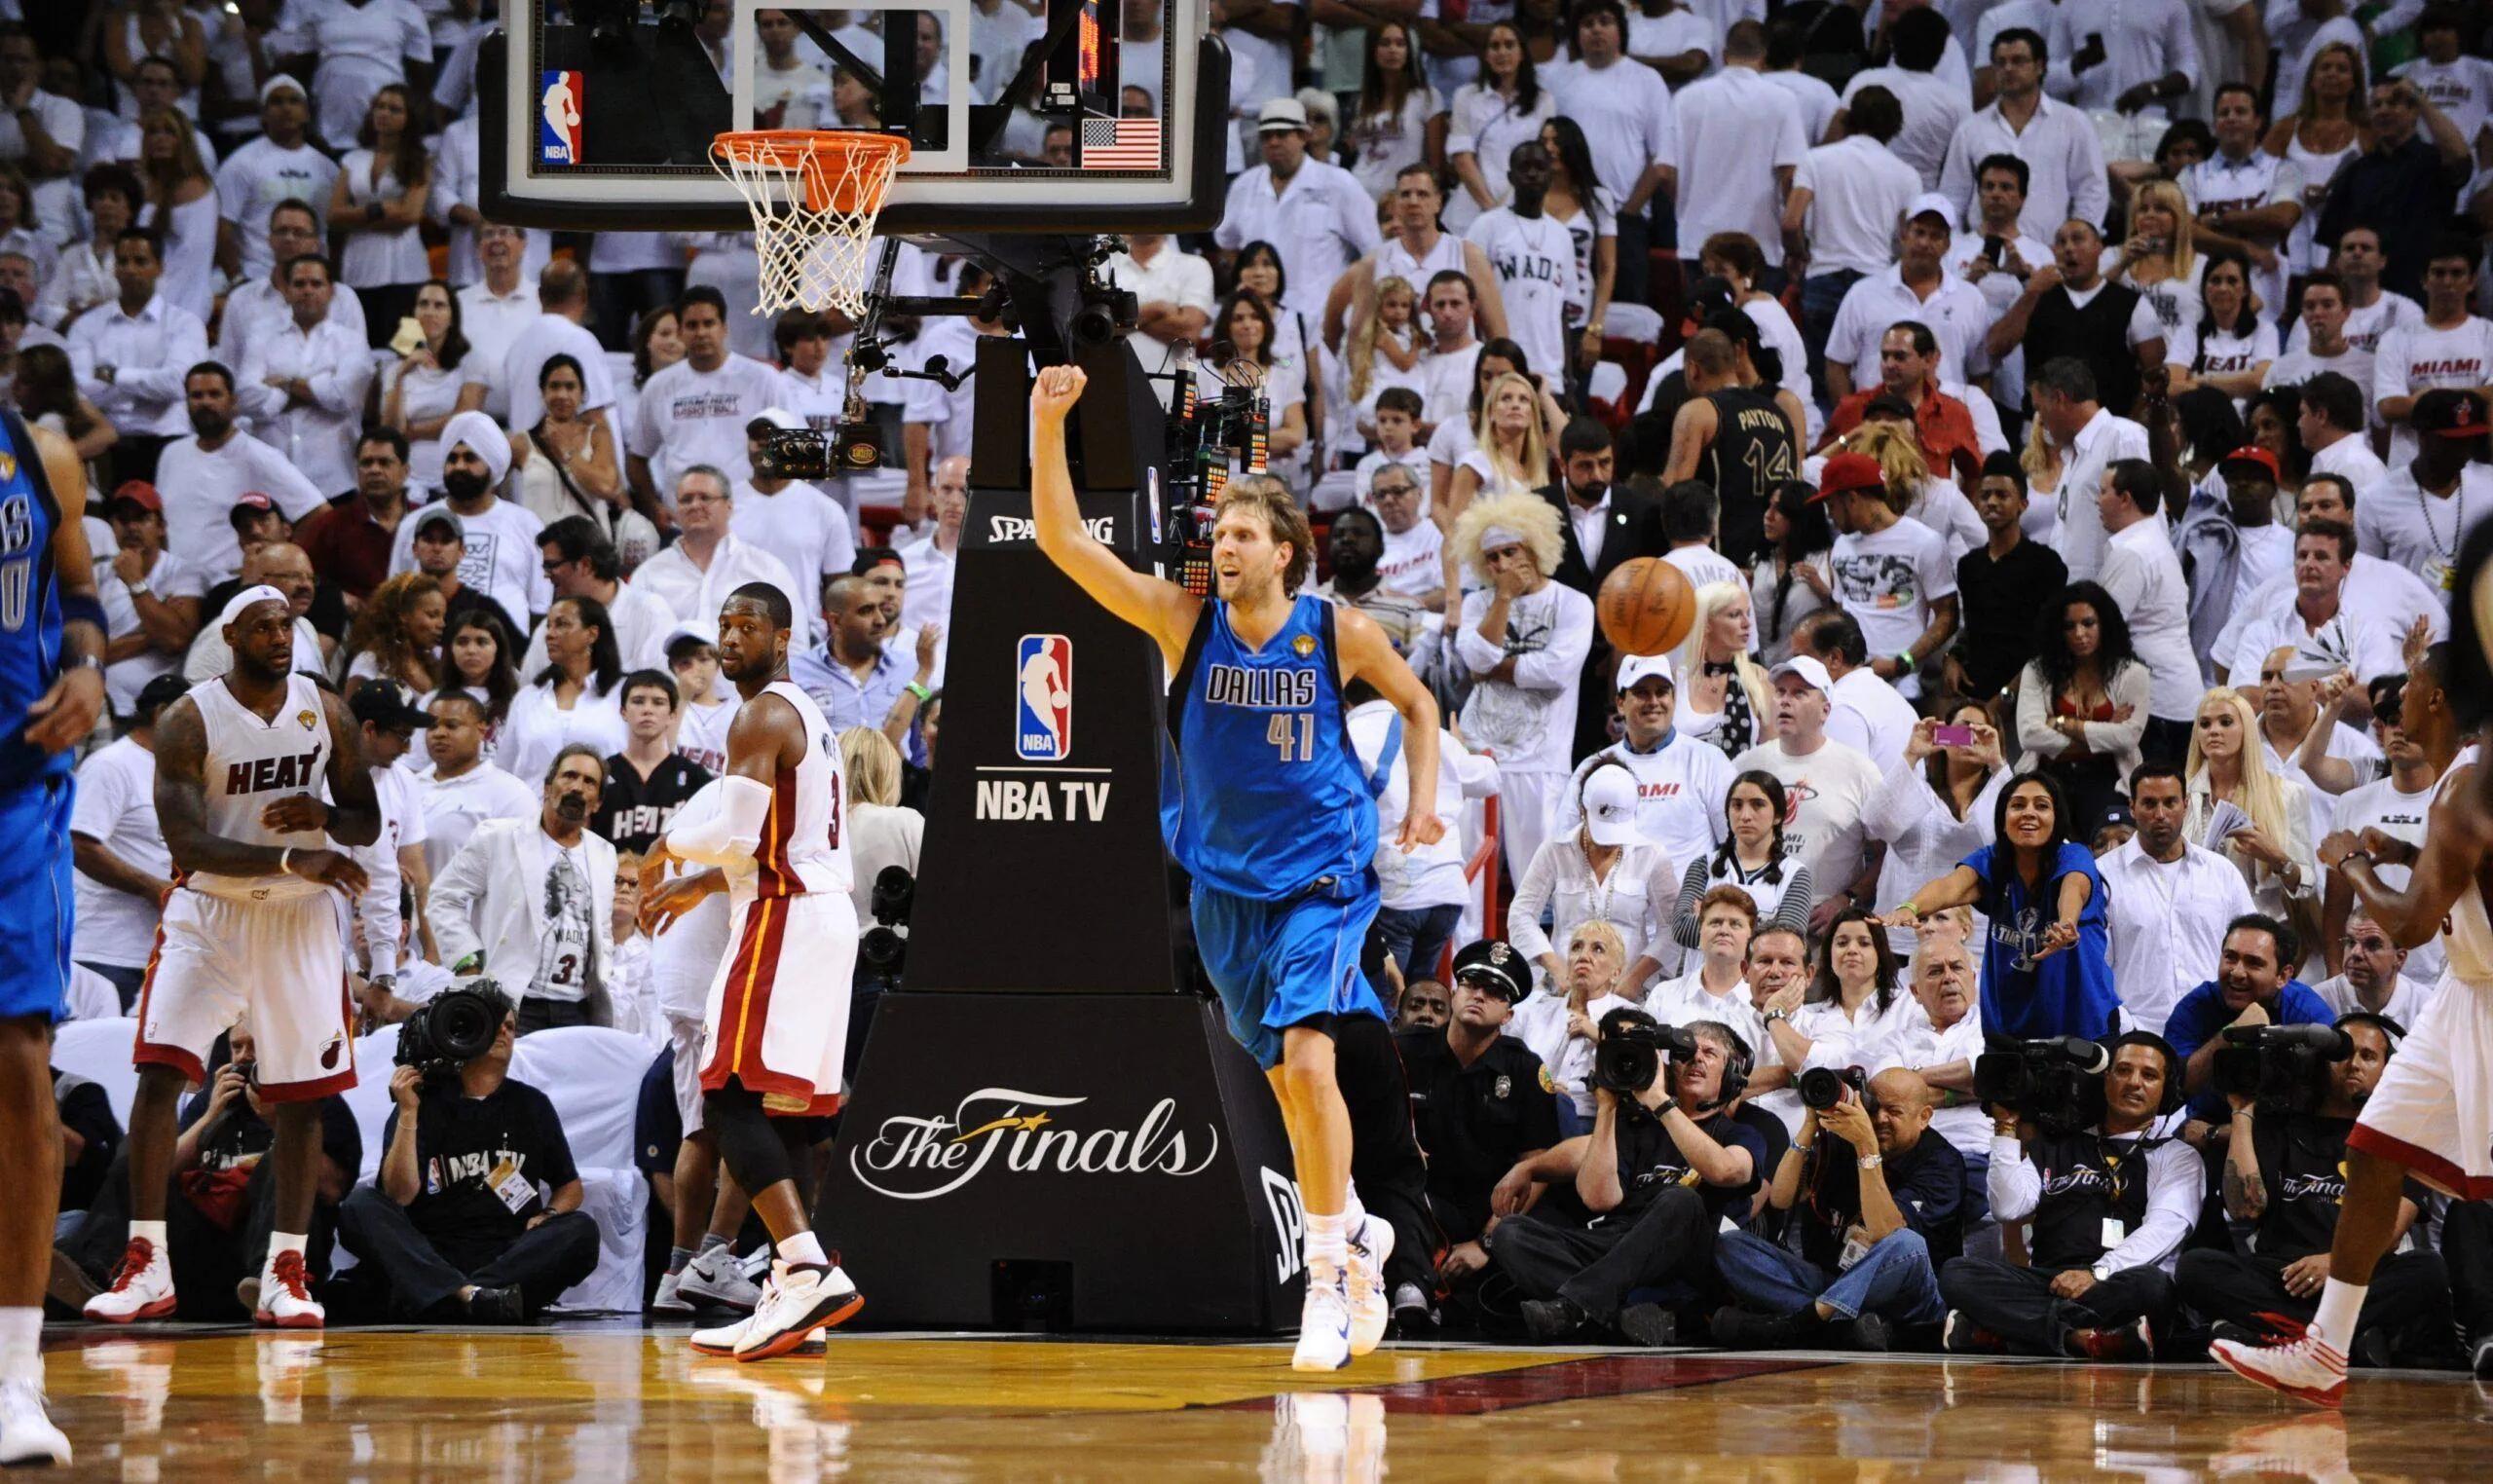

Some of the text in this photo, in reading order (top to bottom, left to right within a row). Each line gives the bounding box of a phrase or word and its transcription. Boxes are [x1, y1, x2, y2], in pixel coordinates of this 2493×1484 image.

[545, 146, 568, 159] NBA
[2203, 352, 2251, 372] EAT
[2411, 358, 2481, 376] MIAMI
[1738, 409, 1785, 434] PAYTON
[1742, 437, 1795, 496] 14
[988, 515, 1115, 545] SPANG
[1206, 663, 1316, 707] DALLAS
[1023, 734, 1053, 751] NBA
[1267, 713, 1314, 761] 41
[227, 741, 322, 795] HEAT
[976, 780, 1110, 821] NBA TV
[1637, 783, 1681, 797] AMI
[550, 954, 577, 984] 3
[850, 1087, 1217, 1200] The Finals
[449, 1150, 491, 1183] NBA
[2282, 1173, 2347, 1202] Fina
